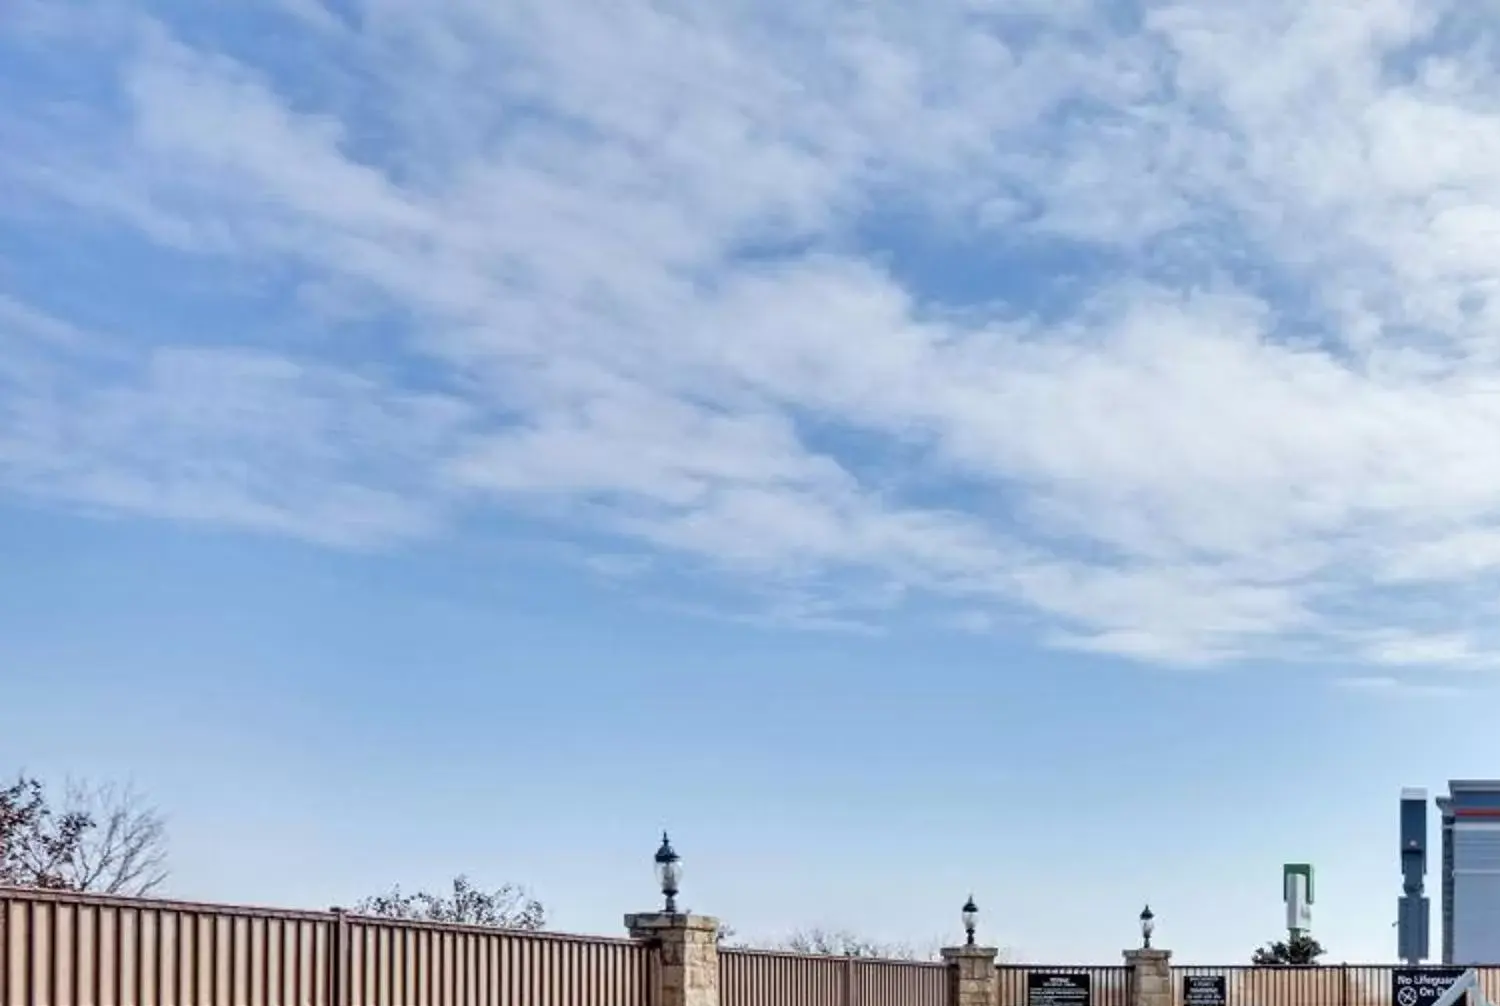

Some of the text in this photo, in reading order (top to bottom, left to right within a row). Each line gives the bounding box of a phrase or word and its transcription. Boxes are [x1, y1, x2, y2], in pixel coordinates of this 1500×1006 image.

[1398, 974, 1461, 986] No Lifeguar
[1420, 987, 1434, 996] On
